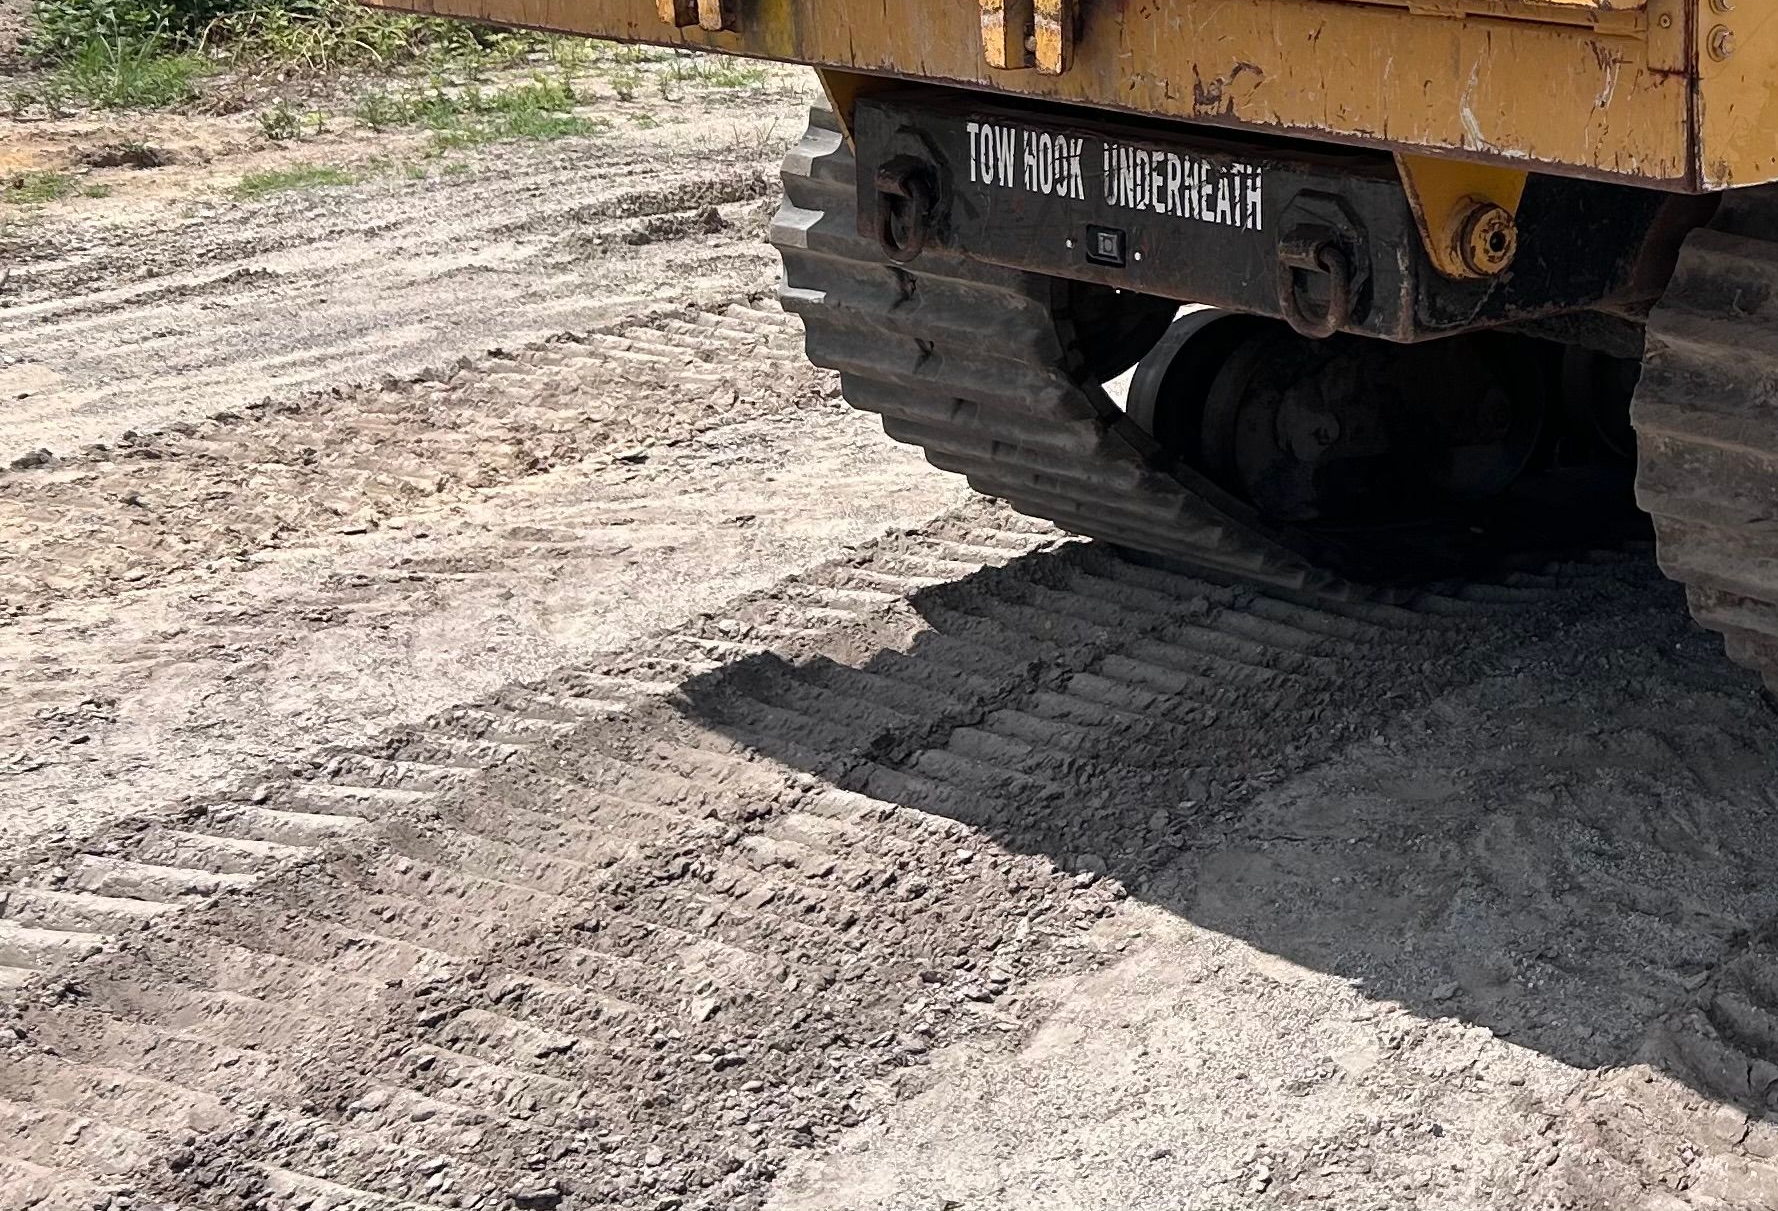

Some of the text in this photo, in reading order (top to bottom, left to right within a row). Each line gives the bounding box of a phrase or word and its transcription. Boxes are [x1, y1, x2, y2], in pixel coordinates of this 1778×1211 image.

[966, 122, 1263, 230] TOW HOOK UNDERNEATH
